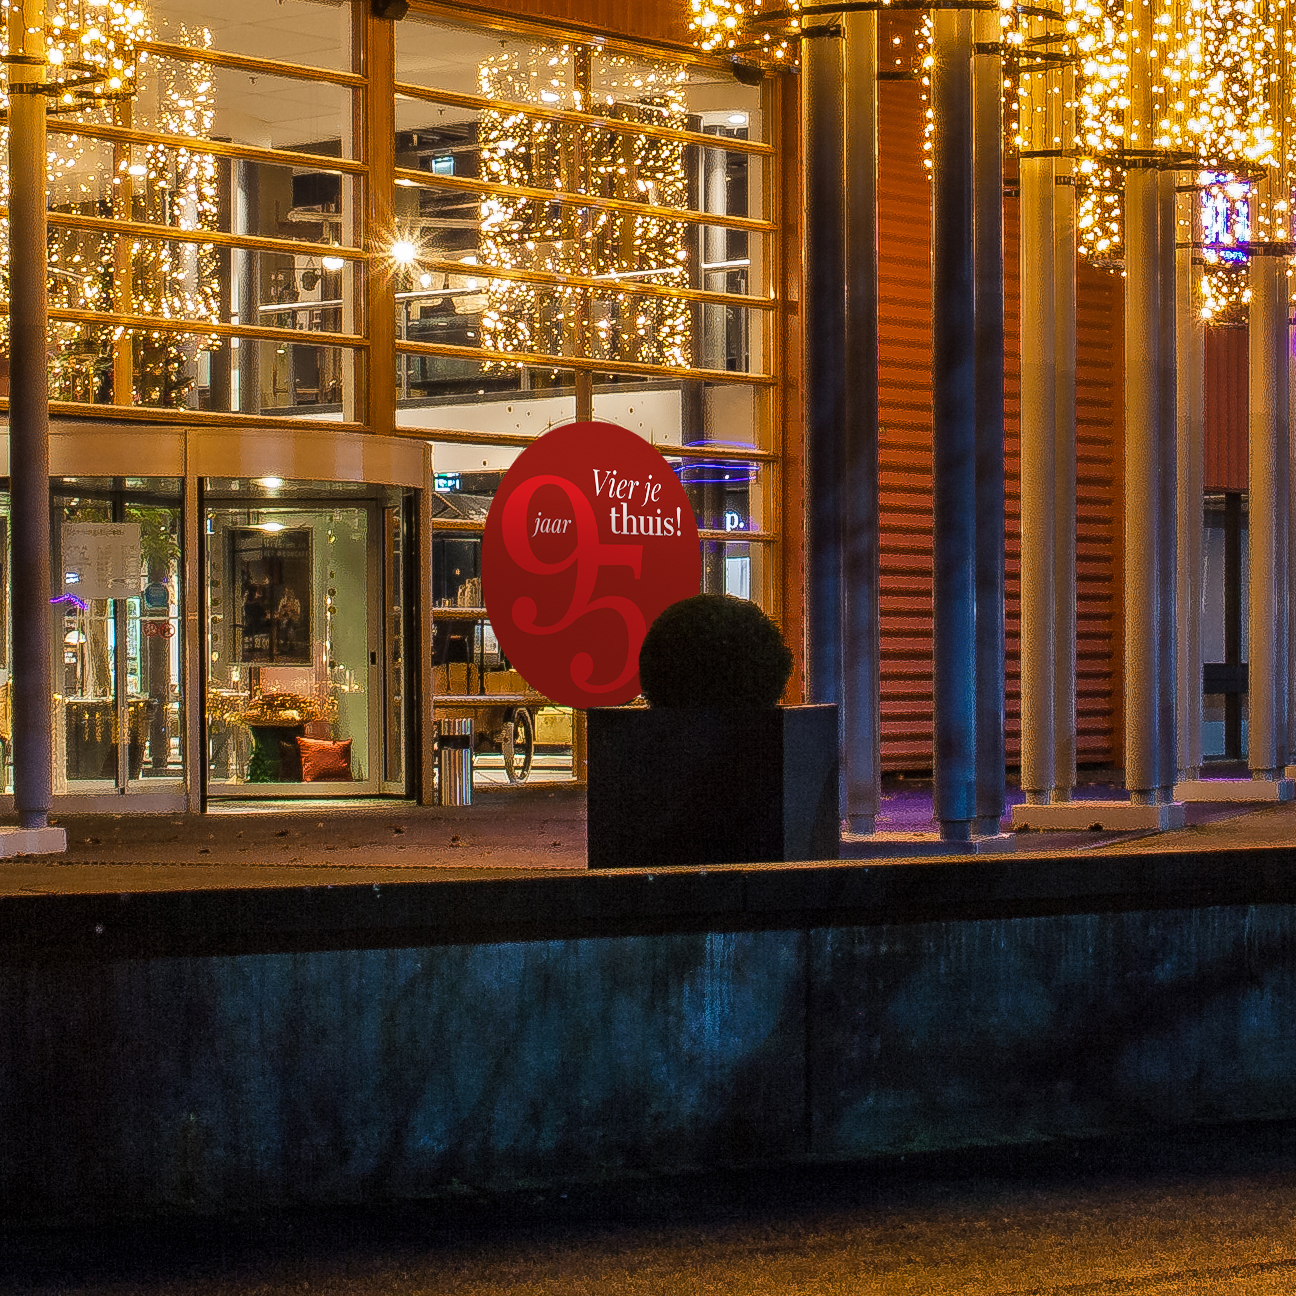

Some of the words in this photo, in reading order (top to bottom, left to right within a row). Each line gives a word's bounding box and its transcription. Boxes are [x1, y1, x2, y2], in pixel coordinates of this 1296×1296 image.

[592, 468, 640, 501] Vier
[640, 474, 662, 507] je
[531, 512, 572, 538] jaar
[609, 502, 682, 537] thuis!
[501, 474, 648, 694] 95
